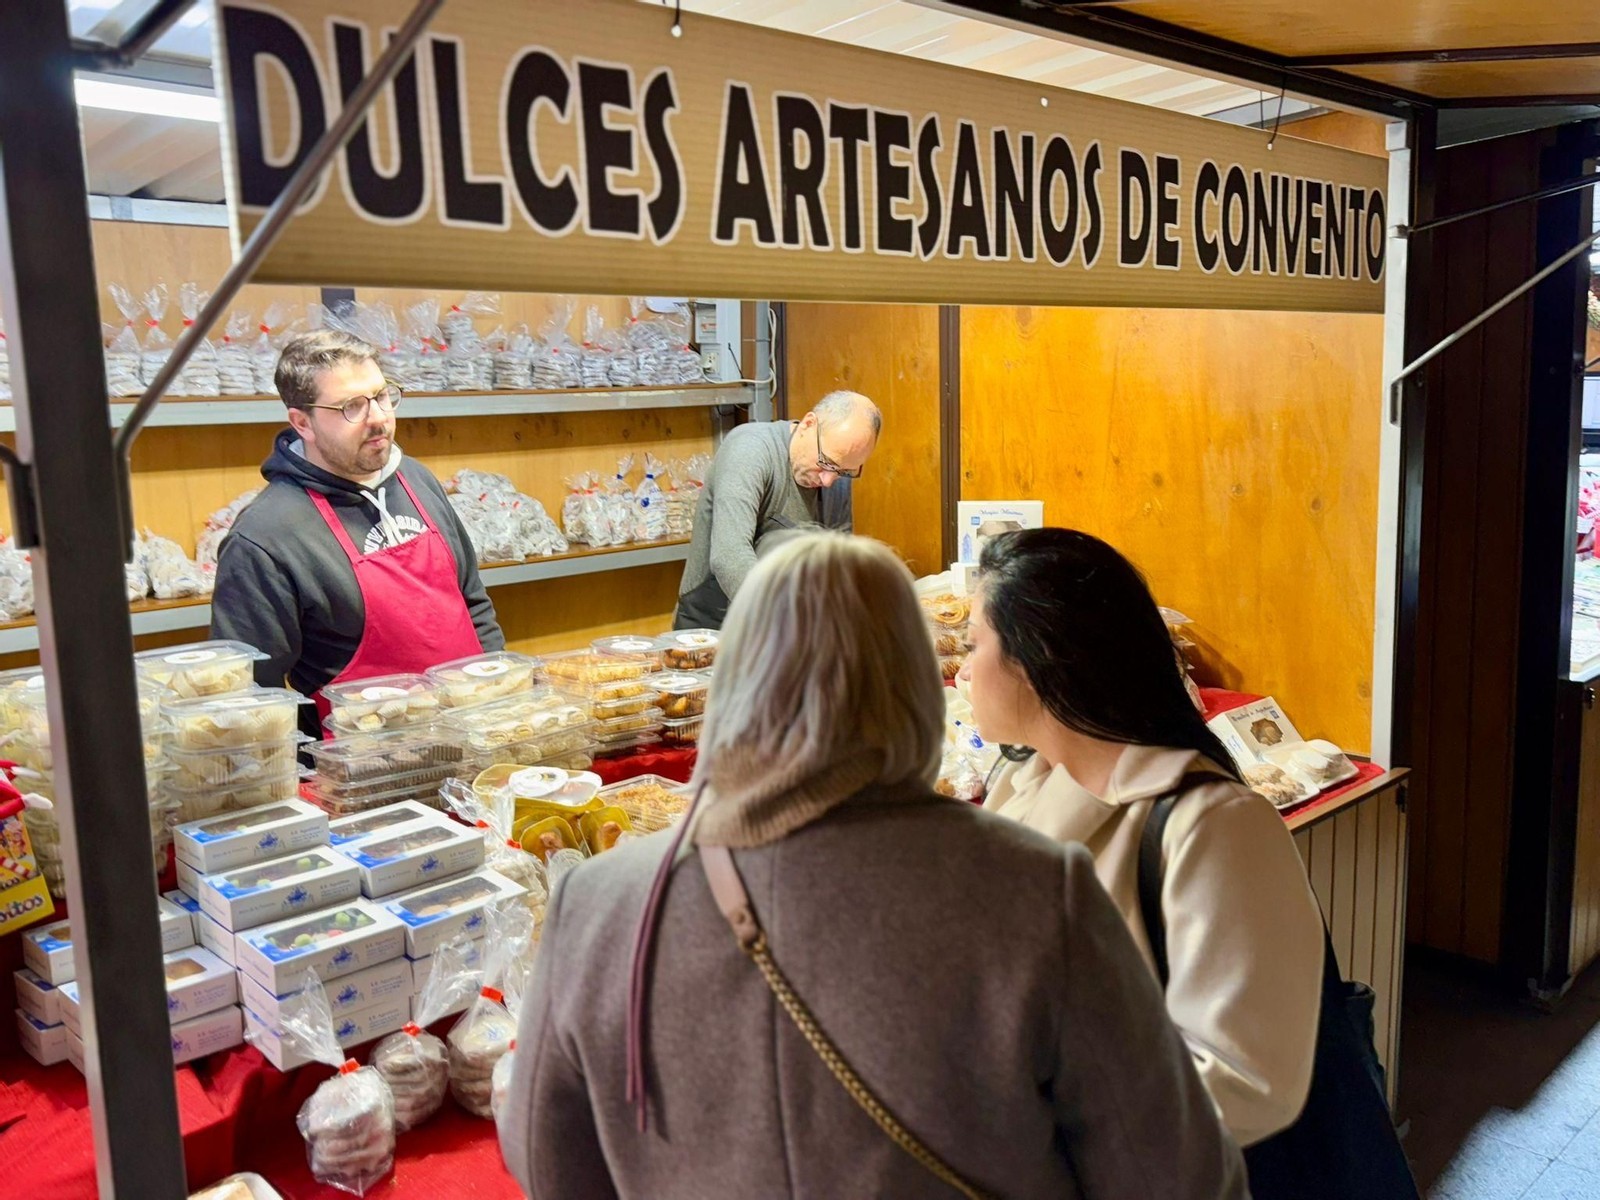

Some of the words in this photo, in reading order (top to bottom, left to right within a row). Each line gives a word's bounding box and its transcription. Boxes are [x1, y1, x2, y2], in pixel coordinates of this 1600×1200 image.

[221, 5, 684, 243] DULCES
[714, 84, 1101, 267] ARTESANOS
[1120, 149, 1180, 268] DE
[1198, 160, 1385, 282] CONVENTO
